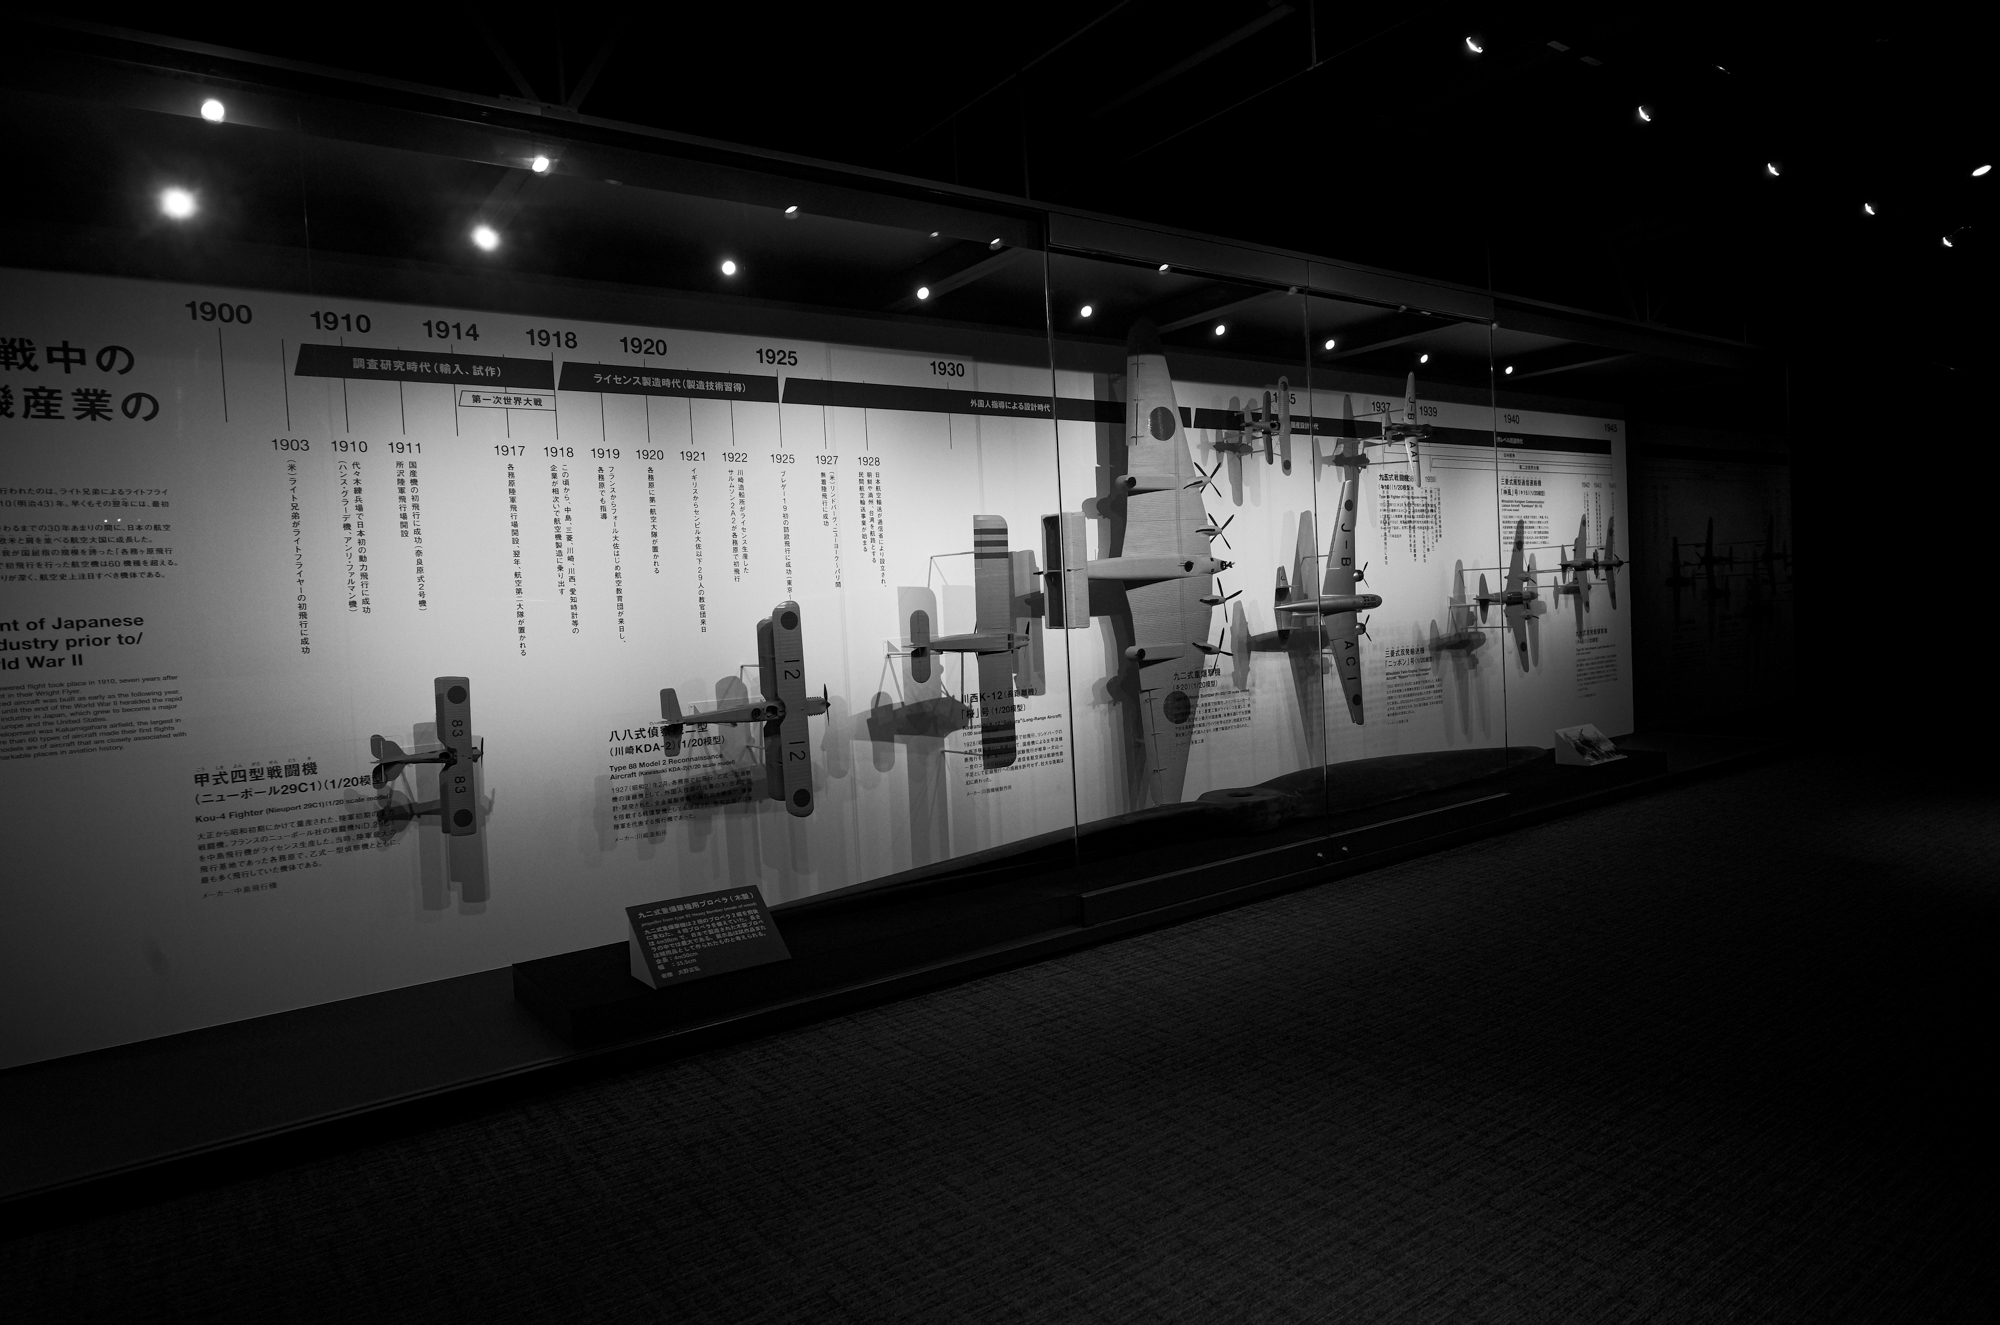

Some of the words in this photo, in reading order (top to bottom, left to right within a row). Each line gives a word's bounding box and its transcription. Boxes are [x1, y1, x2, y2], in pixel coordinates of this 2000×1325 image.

[185, 301, 252, 324] 1900
[311, 311, 371, 333] 1910
[423, 320, 479, 341] 1914
[526, 329, 577, 349] 1918
[620, 337, 667, 356] 1920
[0, 338, 134, 375] 戦中の
[756, 349, 797, 366] 1925
[930, 361, 964, 377] 1930
[471, 394, 543, 407] 第一次世界大戦
[1372, 402, 1390, 413] 1937
[1419, 406, 1438, 417] 1939
[1503, 414, 1520, 425] 1940
[1604, 423, 1618, 433] 1945
[272, 439, 309, 451] 1903
[332, 441, 367, 452] 1910
[388, 442, 420, 453] 1911
[494, 445, 525, 456] 1917
[544, 447, 574, 457] 1918
[591, 448, 619, 459] 1919
[636, 450, 663, 460] 1920
[680, 451, 705, 461] 1921
[722, 453, 747, 462] 1922
[771, 454, 795, 463] 1925
[816, 455, 838, 464] 1927
[858, 457, 880, 466] 1928
[26, 618, 45, 630] of
[52, 617, 144, 631] Japanese
[66, 635, 111, 650] prior
[117, 632, 143, 645] to/
[0, 657, 19, 670] ld
[26, 656, 65, 668] War
[72, 654, 83, 666] II
[784, 659, 801, 680] 12
[452, 719, 463, 738] 83
[789, 741, 806, 761] 12
[609, 764, 627, 773] Type
[638, 760, 661, 768] Model
[668, 753, 724, 765] Reconnaissance
[194, 761, 318, 787] 甲式四型戦闘機
[610, 772, 637, 780] Aircraft
[454, 776, 466, 794] 83
[195, 813, 226, 823] Kou-4
[229, 808, 264, 819] Fighter
[265, 804, 302, 815] (Nieuport
[345, 797, 365, 805] scale
